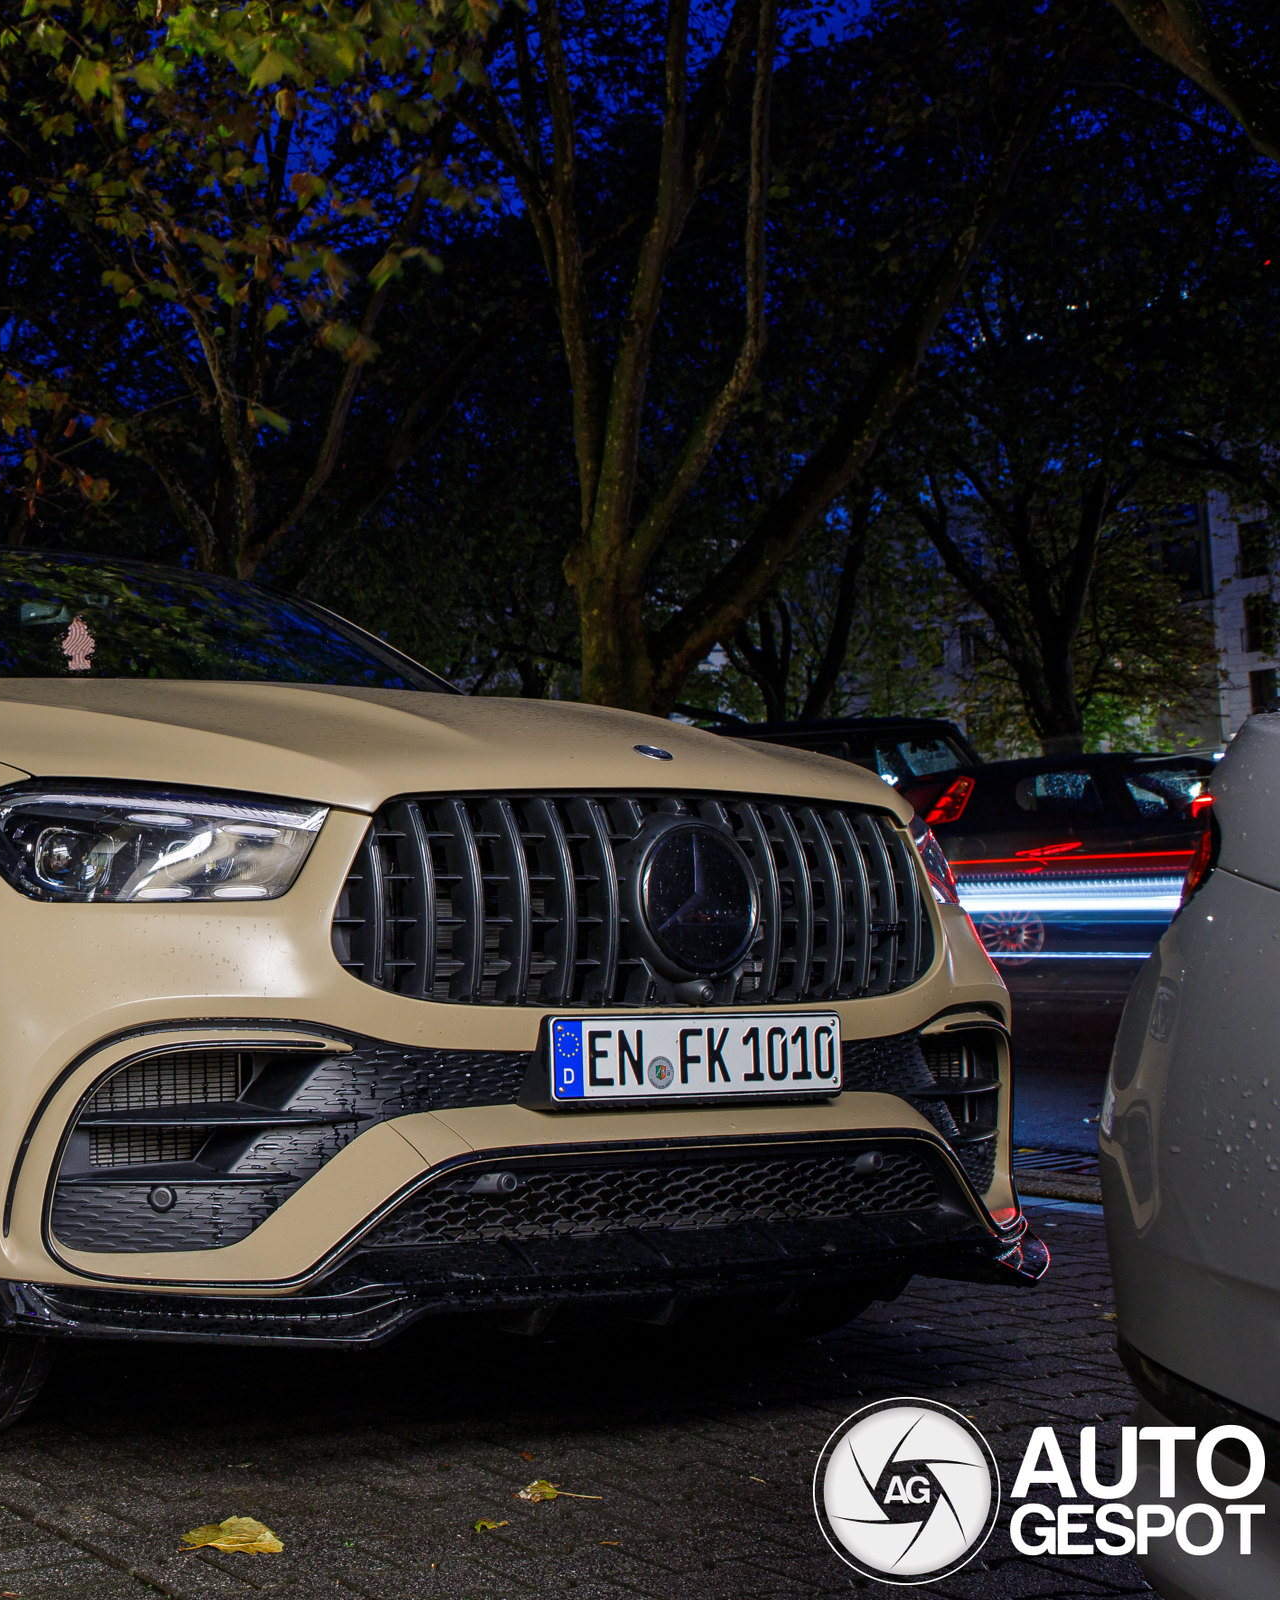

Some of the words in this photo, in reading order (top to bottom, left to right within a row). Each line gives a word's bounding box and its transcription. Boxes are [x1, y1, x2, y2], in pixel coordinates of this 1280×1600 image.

[563, 1067, 575, 1085] D
[587, 1028, 644, 1087] EN
[678, 1026, 732, 1084] FK
[741, 1025, 834, 1082] 1010
